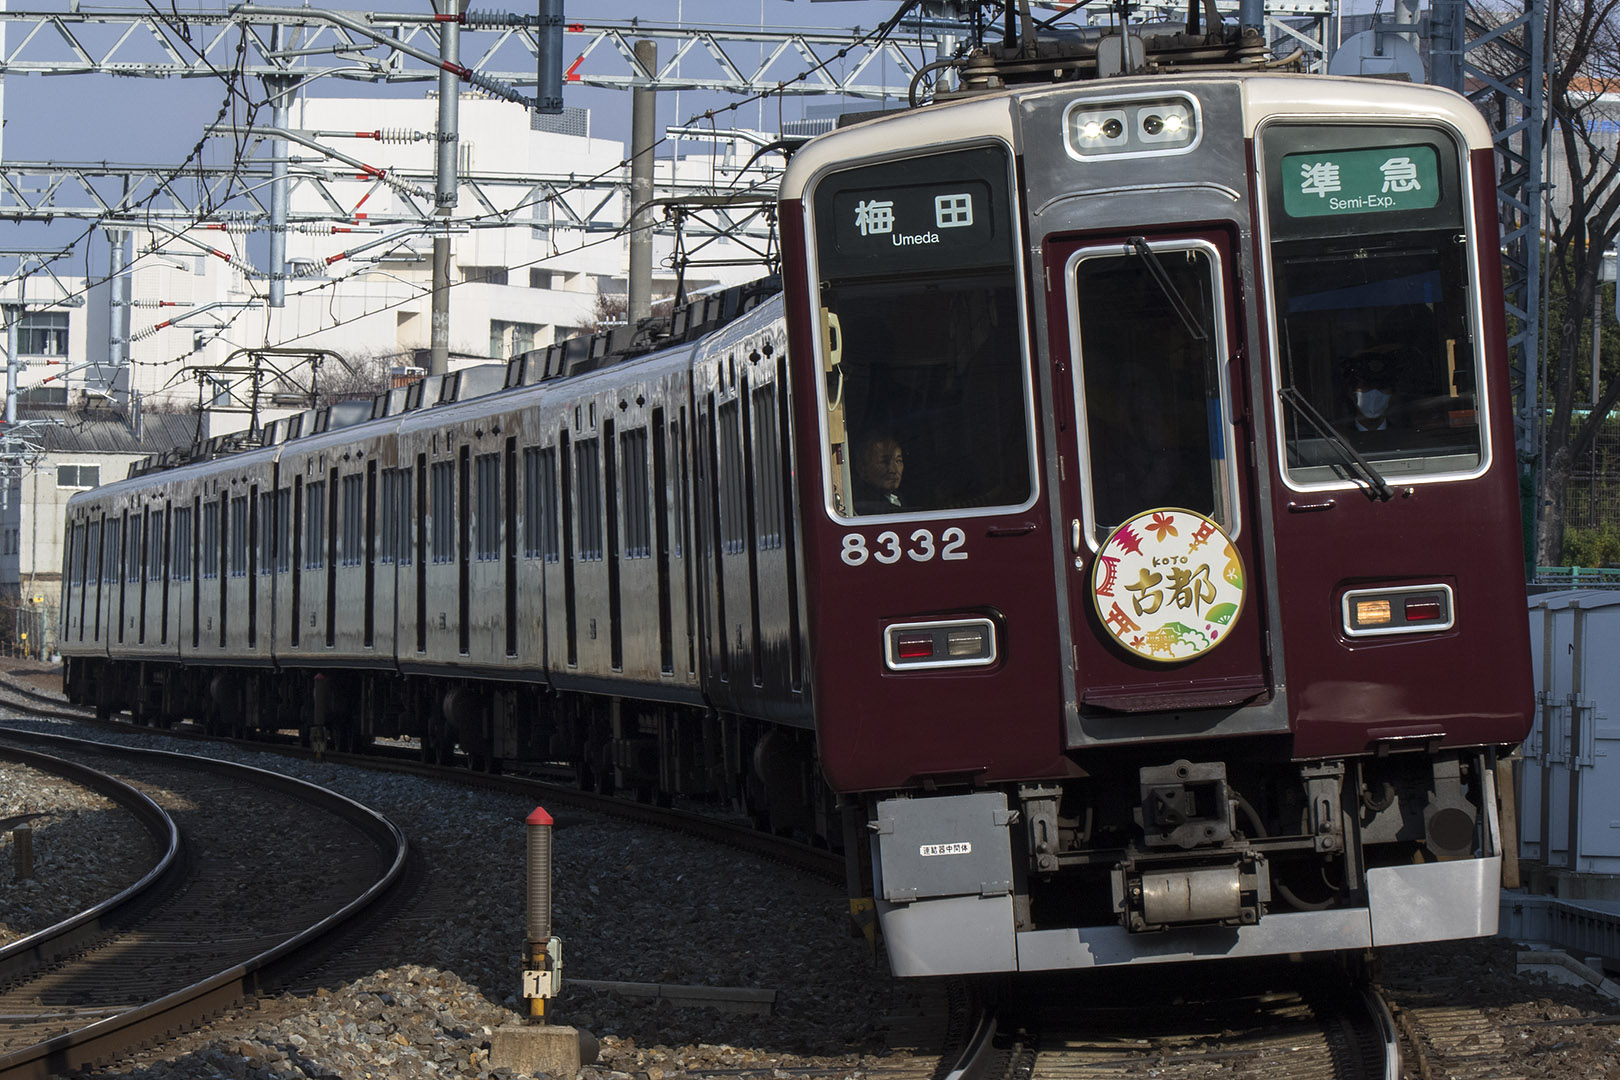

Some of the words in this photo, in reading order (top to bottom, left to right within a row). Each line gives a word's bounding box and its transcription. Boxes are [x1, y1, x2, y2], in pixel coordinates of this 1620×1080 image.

[1300, 157, 1422, 198] 準急
[855, 193, 974, 236] 梅田
[1329, 194, 1397, 210] Semi-Exp.
[892, 231, 940, 246] Umeda
[840, 526, 969, 567] 8332
[1152, 555, 1188, 568] KOTO
[1123, 563, 1217, 617] 古都
[532, 975, 540, 995] 1
